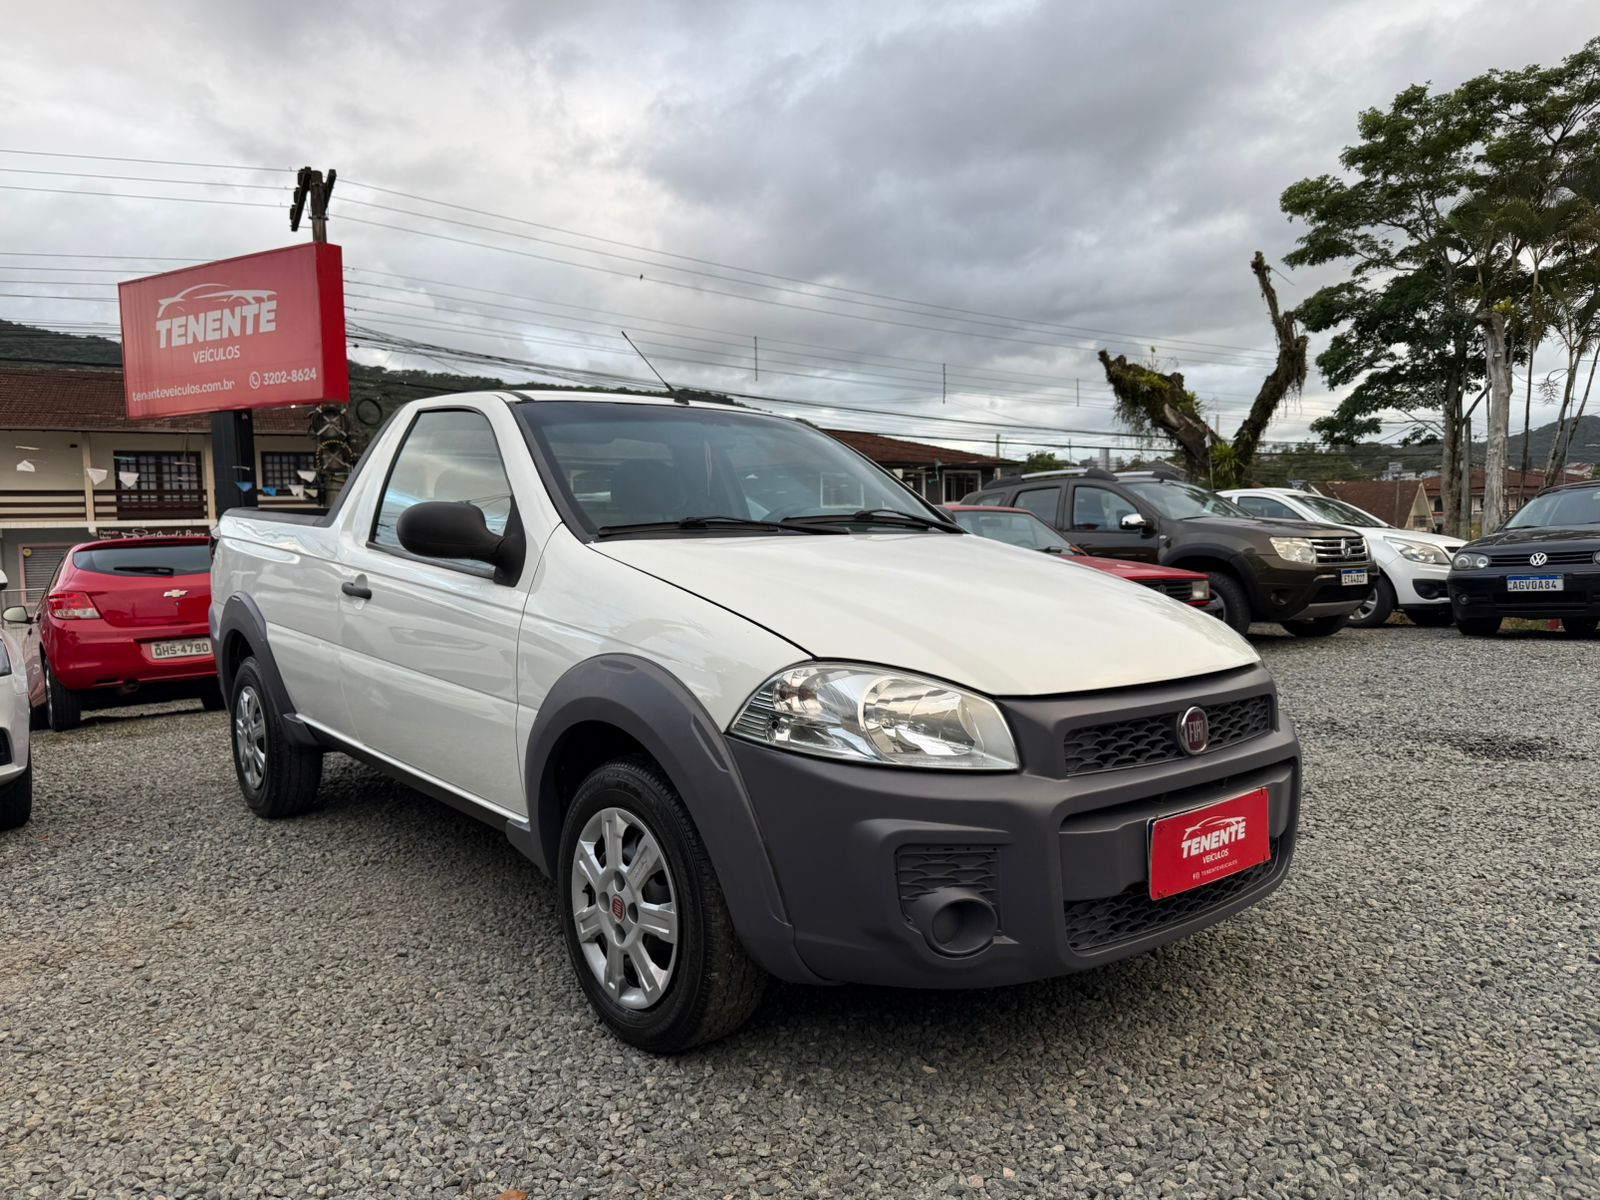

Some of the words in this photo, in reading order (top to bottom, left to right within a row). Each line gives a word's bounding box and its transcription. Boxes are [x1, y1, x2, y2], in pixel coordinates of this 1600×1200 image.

[156, 300, 278, 349] TENENTE
[193, 345, 241, 364] VEÍCULOS
[263, 367, 317, 385] 3202-8624
[1188, 719, 1204, 744] FIAT
[1181, 821, 1247, 859] TENENTE
